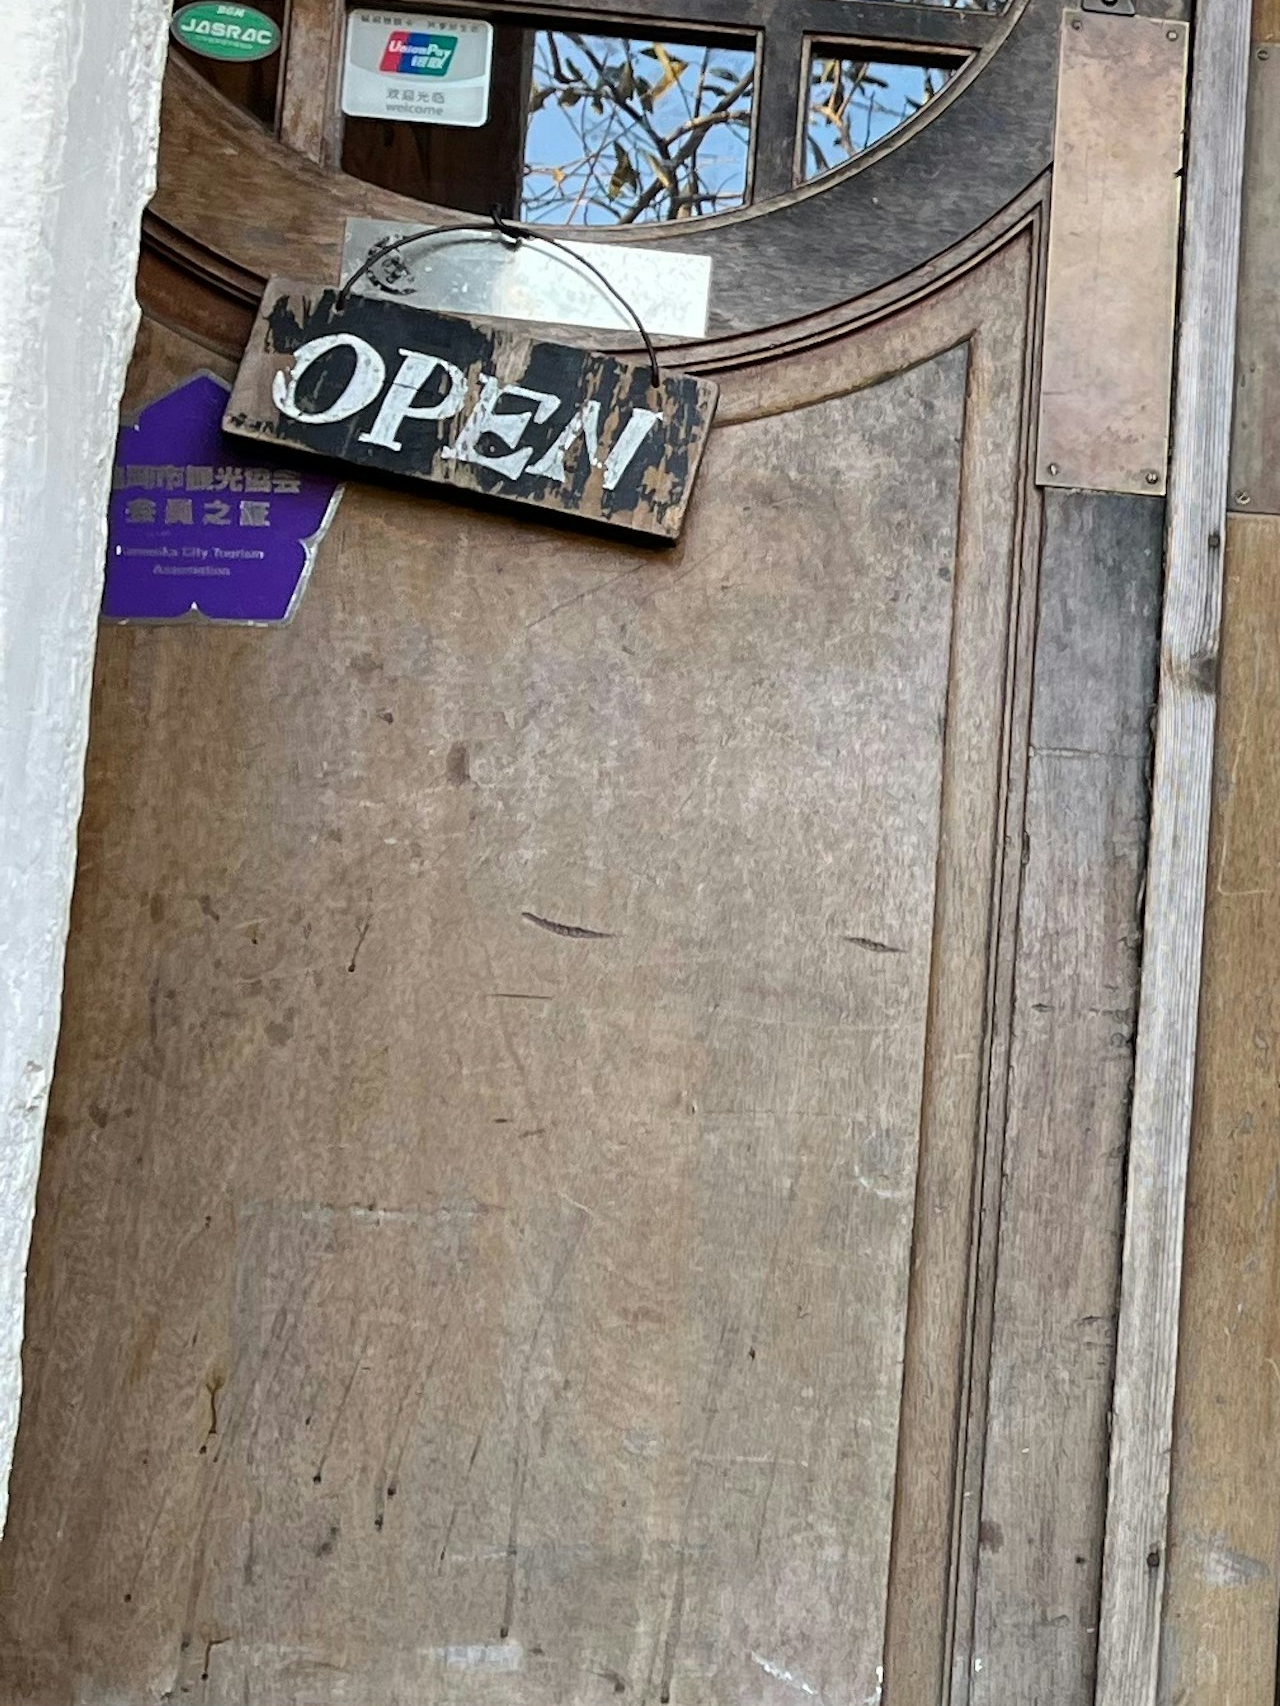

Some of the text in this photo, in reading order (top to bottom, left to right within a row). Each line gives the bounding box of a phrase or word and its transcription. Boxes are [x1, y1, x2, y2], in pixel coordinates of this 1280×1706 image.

[180, 18, 273, 45] JASRAC
[388, 39, 452, 62] UnionPay
[385, 103, 444, 116] welcome
[272, 333, 665, 492] OPEN
